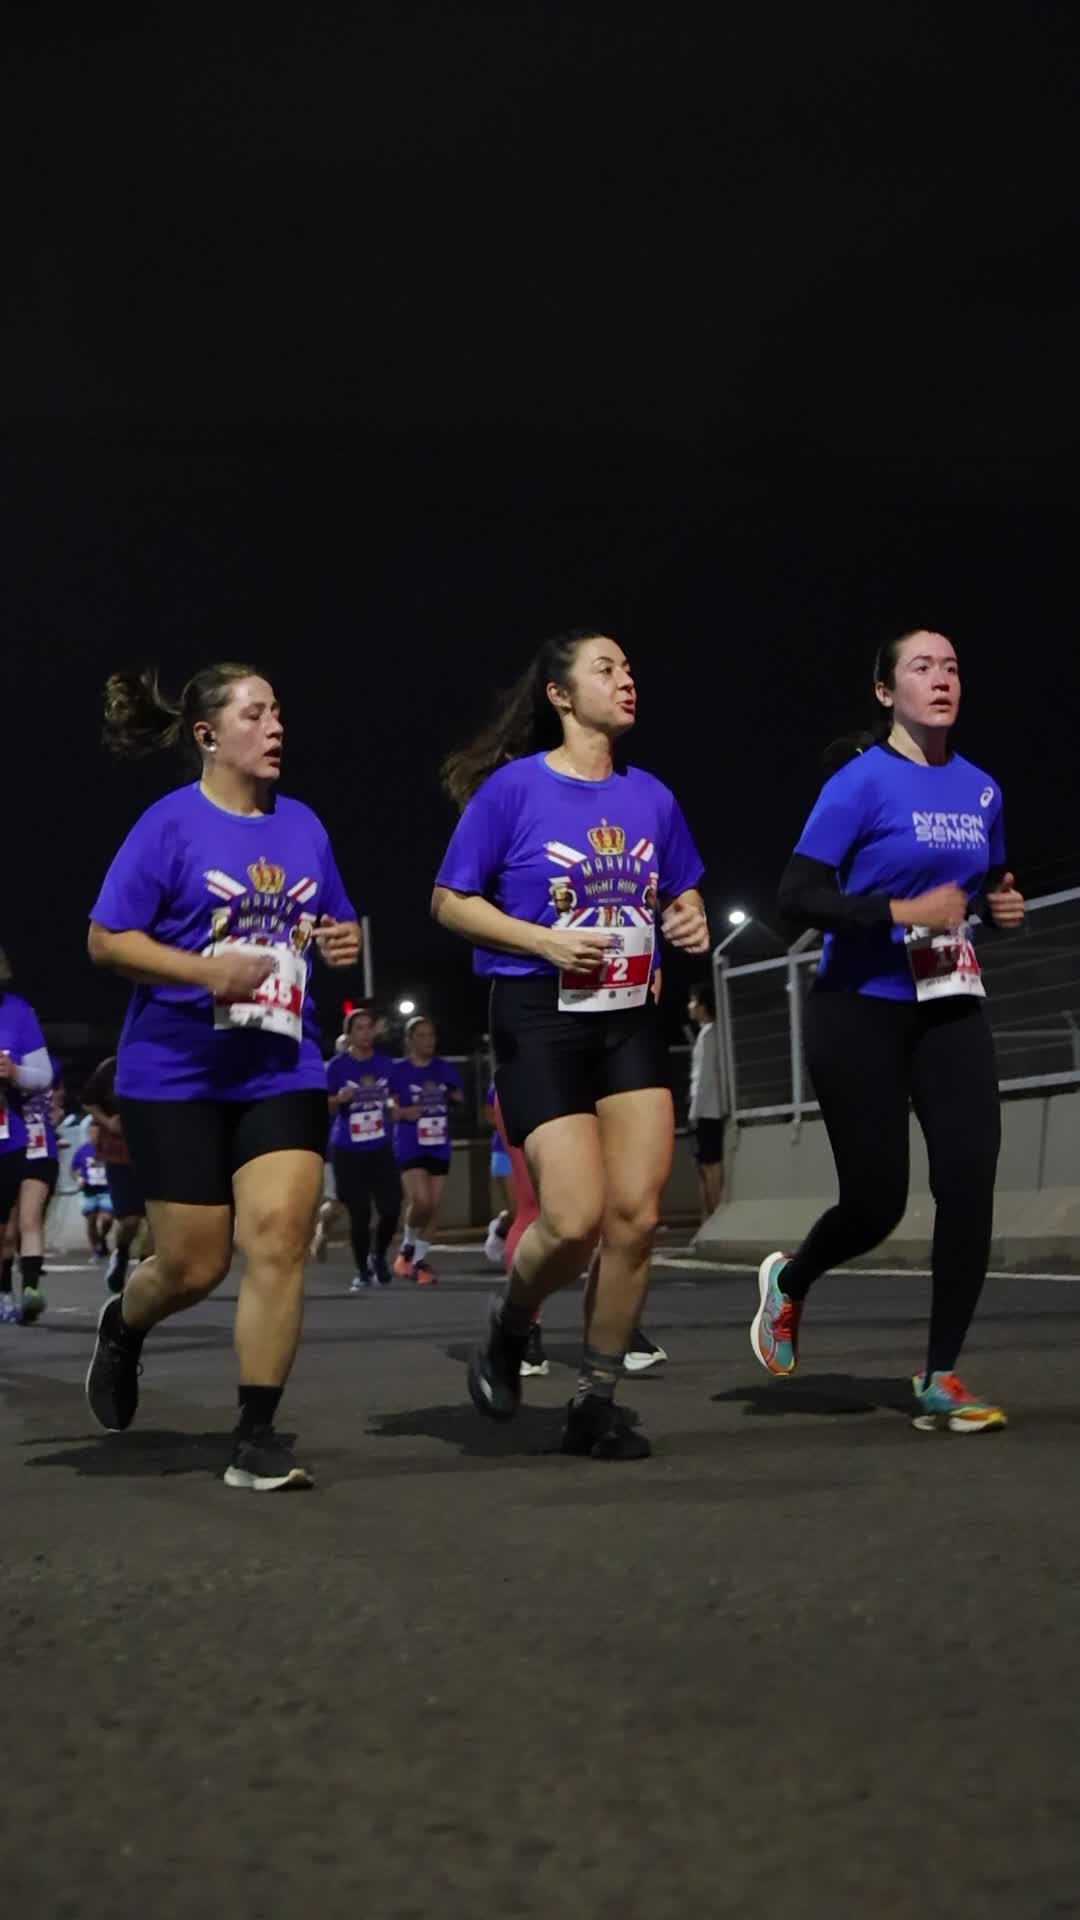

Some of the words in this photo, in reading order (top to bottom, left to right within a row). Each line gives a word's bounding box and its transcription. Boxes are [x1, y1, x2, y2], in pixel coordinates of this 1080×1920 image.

[581, 855, 641, 878] MARVIN
[584, 879, 614, 896] NIGHT
[617, 880, 638, 895] RUN
